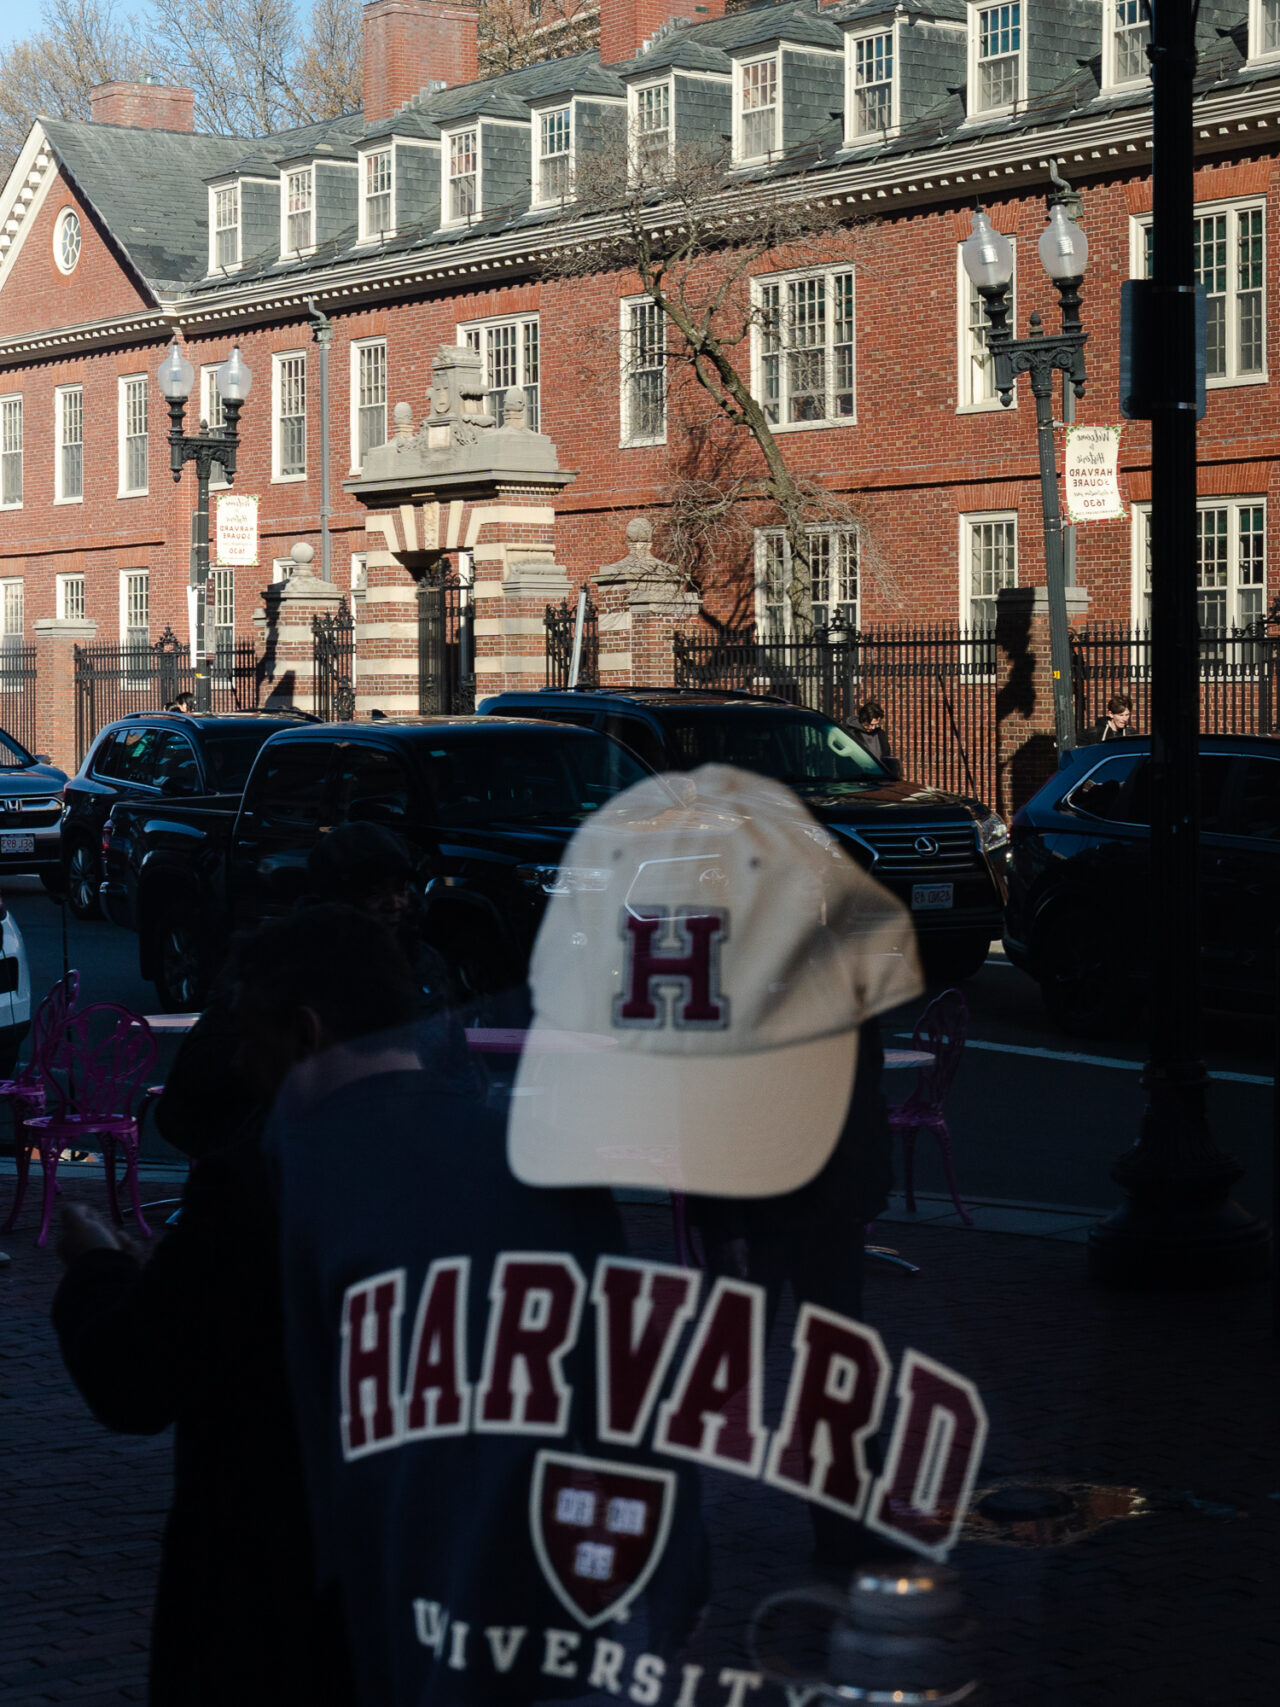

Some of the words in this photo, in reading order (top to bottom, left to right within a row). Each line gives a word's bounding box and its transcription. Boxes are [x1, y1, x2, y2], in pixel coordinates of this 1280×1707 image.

[611, 903, 730, 1033] H
[340, 1250, 990, 1563] HARVARD
[412, 1597, 822, 1707] UIVERSIT
